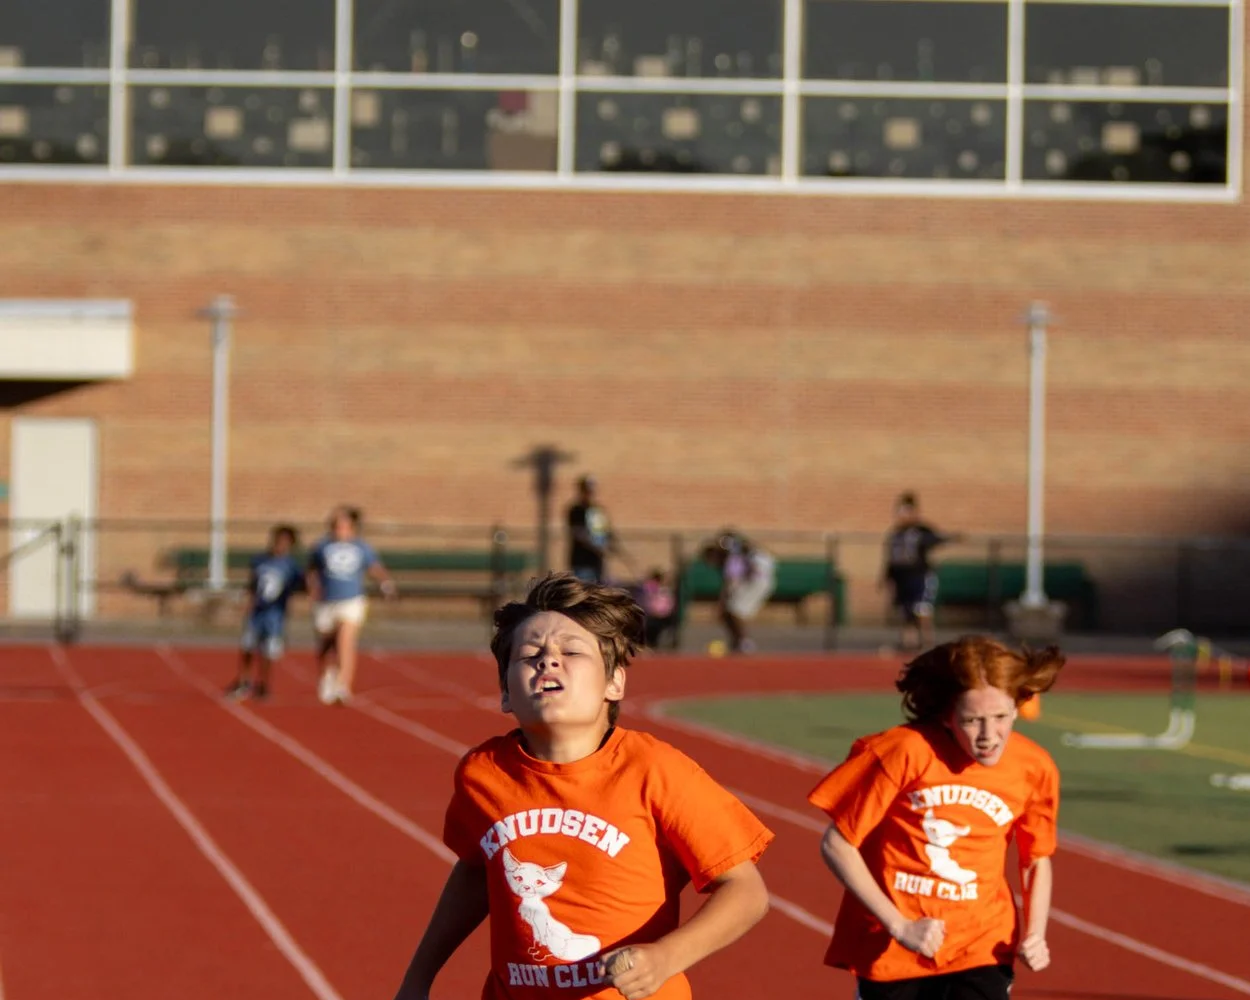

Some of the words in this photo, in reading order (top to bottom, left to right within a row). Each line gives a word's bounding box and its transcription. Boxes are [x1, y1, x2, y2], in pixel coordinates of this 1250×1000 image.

[907, 784, 1014, 828] KNUDSEN
[480, 808, 630, 860] KNUDSEN
[894, 871, 935, 897] RUN
[507, 962, 549, 987] RUN
[554, 961, 603, 989] CLU
